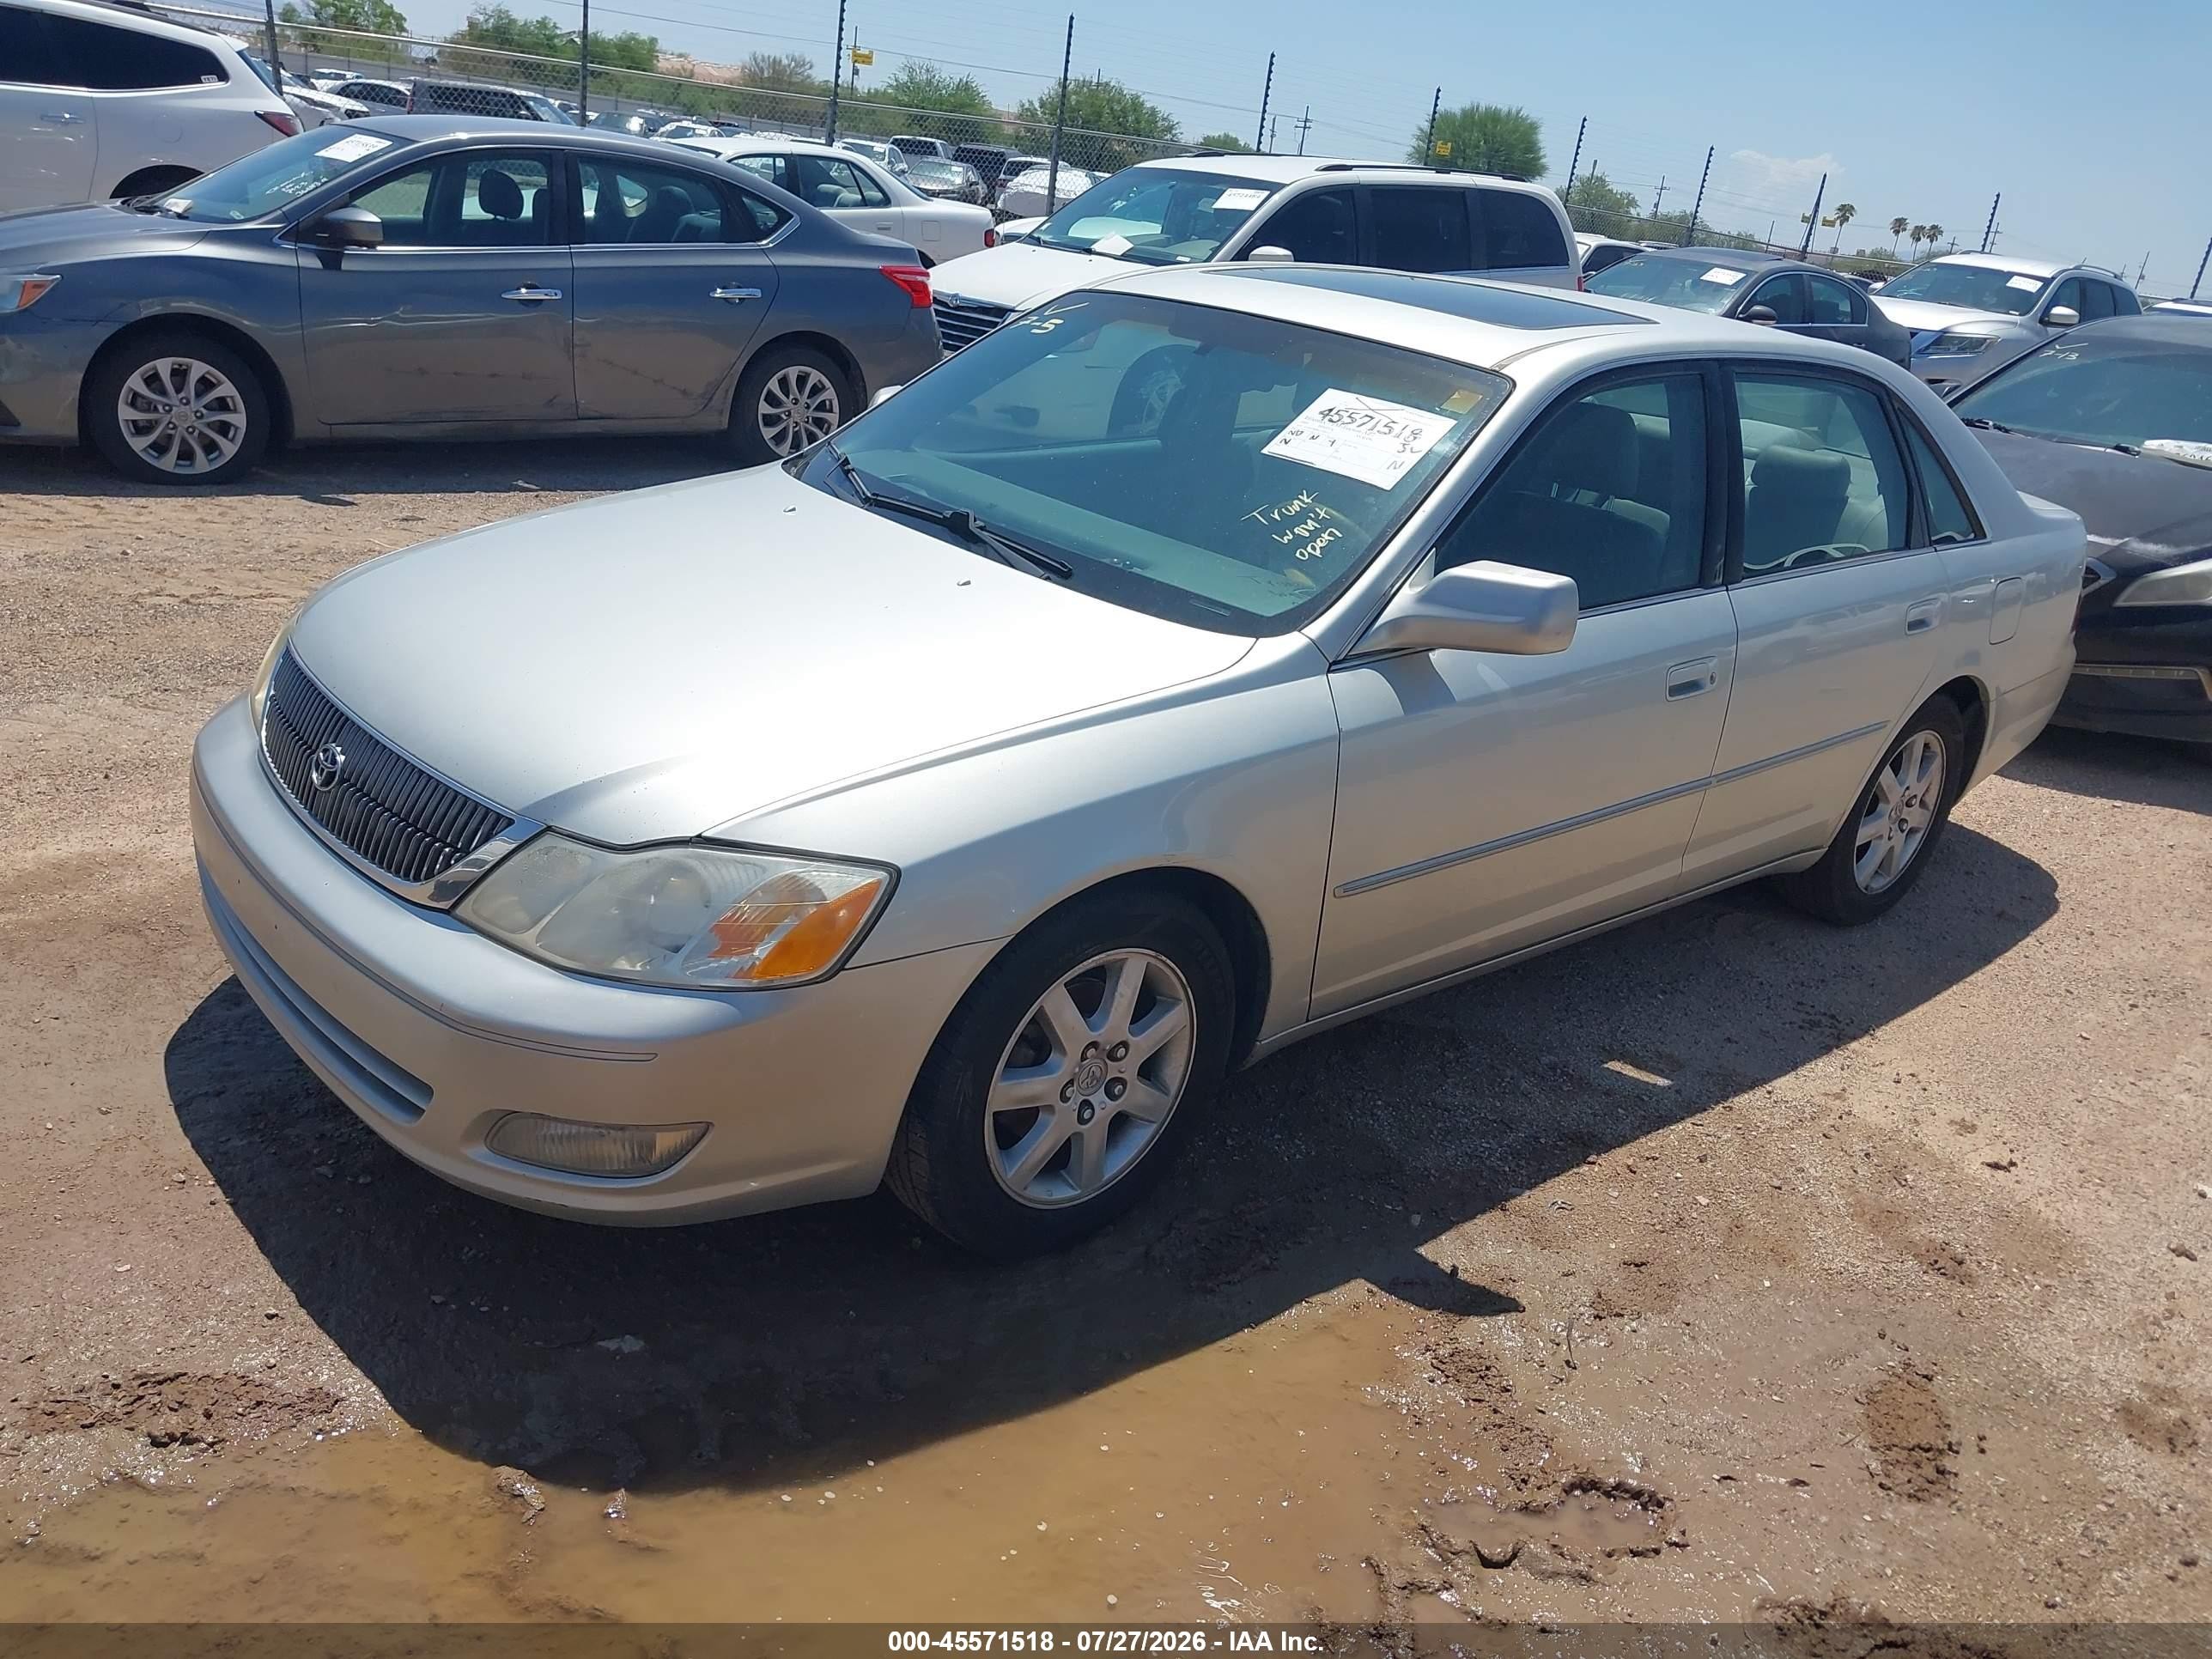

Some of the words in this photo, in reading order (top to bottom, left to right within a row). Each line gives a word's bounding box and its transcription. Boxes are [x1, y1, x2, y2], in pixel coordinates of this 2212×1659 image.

[2039, 349, 2080, 360] 7-13
[1318, 406, 1424, 442] 45571518
[1240, 489, 1320, 526] Trunk
[1295, 527, 1344, 561] open
